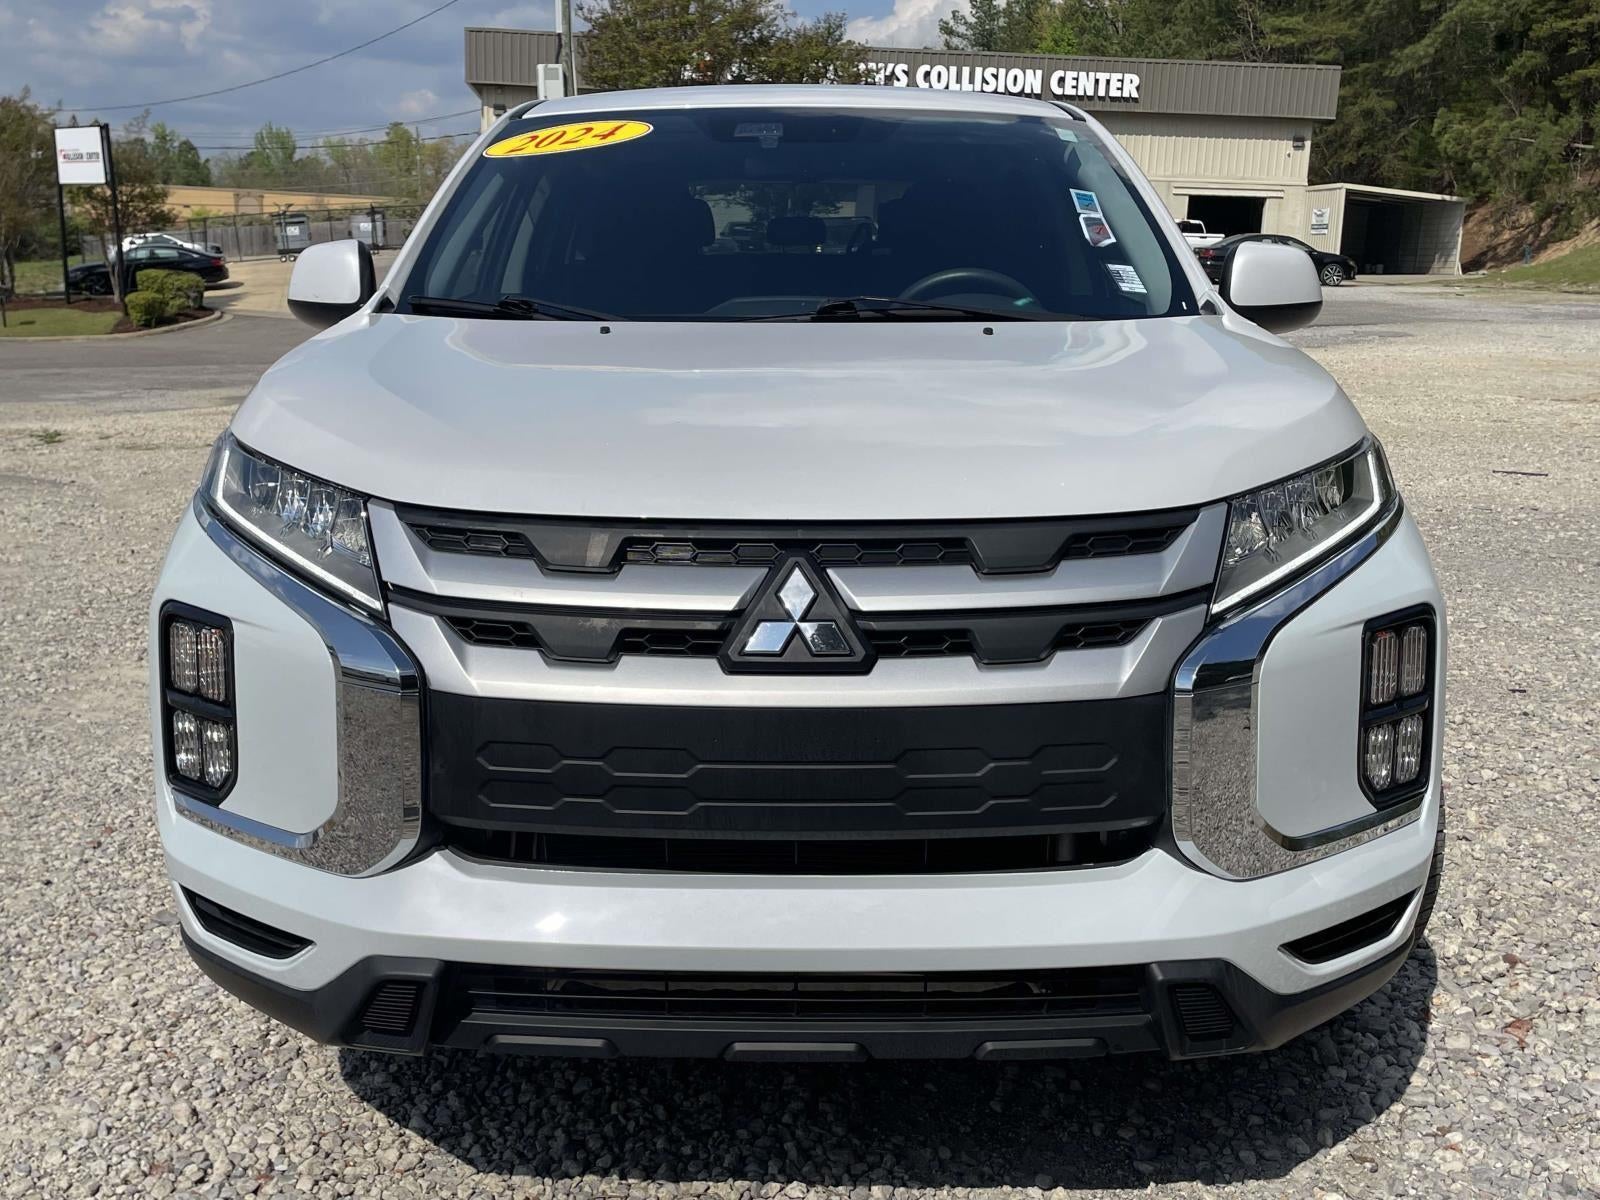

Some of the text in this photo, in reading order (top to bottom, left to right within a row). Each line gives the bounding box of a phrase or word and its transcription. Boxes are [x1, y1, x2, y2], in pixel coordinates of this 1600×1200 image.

[915, 64, 1043, 95] COLLISION
[1050, 70, 1140, 98] CENTER
[503, 123, 628, 154] 2024
